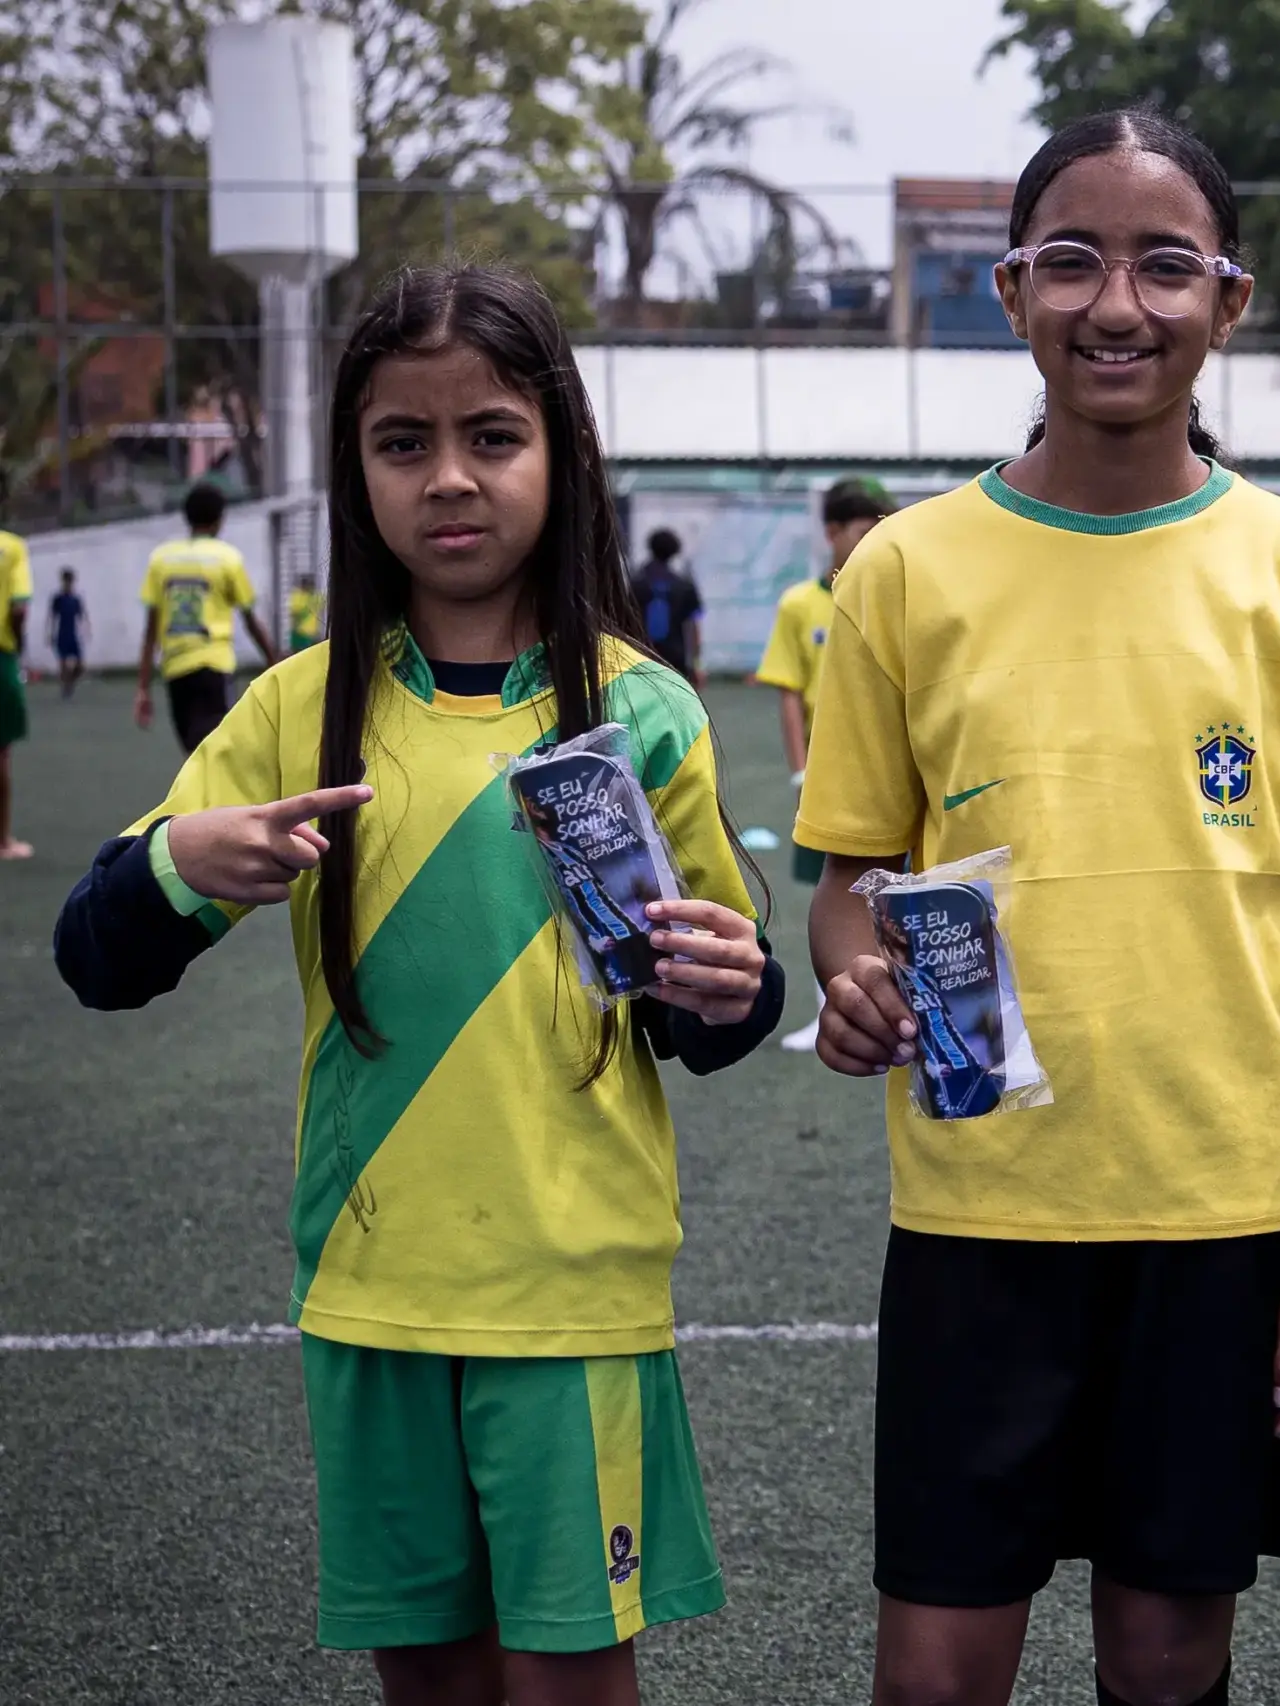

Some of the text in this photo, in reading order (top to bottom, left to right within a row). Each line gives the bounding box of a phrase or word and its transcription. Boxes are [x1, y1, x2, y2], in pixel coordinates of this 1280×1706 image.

[1213, 764, 1236, 775] CBF
[537, 779, 583, 805] SE EU
[554, 788, 609, 821] POSSO
[556, 802, 628, 841] SONHAR
[1202, 812, 1256, 827] BRASIL
[578, 836, 592, 848] EU
[902, 910, 948, 931] SE EU
[917, 922, 971, 948] POSSO
[915, 938, 986, 967] SONHAR
[935, 959, 978, 977] EU POSSO
